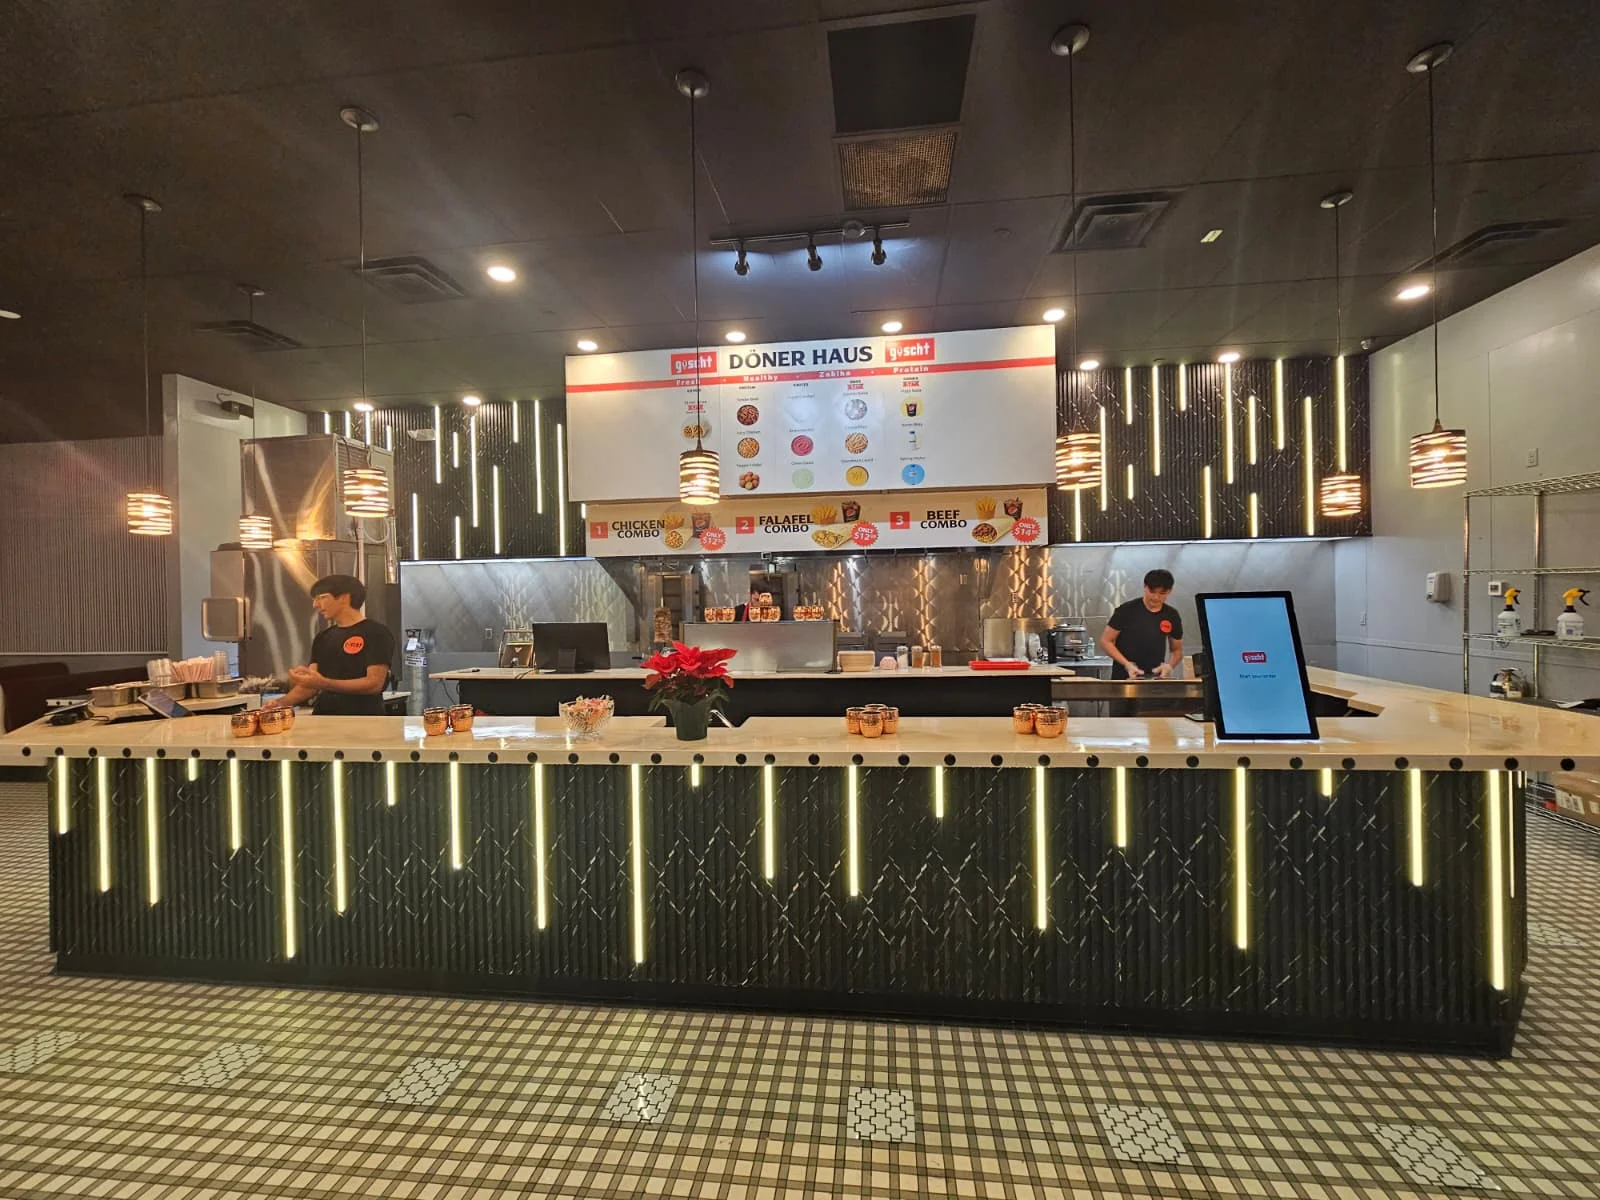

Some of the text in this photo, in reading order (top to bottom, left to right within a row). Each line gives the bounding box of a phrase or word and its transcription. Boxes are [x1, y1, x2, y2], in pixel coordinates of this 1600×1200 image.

[729, 346, 873, 370] DÖNER HAUS
[818, 369, 851, 378] Zabiha
[893, 366, 929, 374] Protein
[759, 514, 814, 526] FALAFEL
[926, 510, 960, 520] BEEF
[612, 519, 665, 531] CHICKEN
[741, 520, 749, 530] 2
[895, 515, 904, 526] 3
[920, 519, 967, 529] COMBO
[617, 529, 660, 539] COMBO
[764, 524, 809, 534] COMBO
